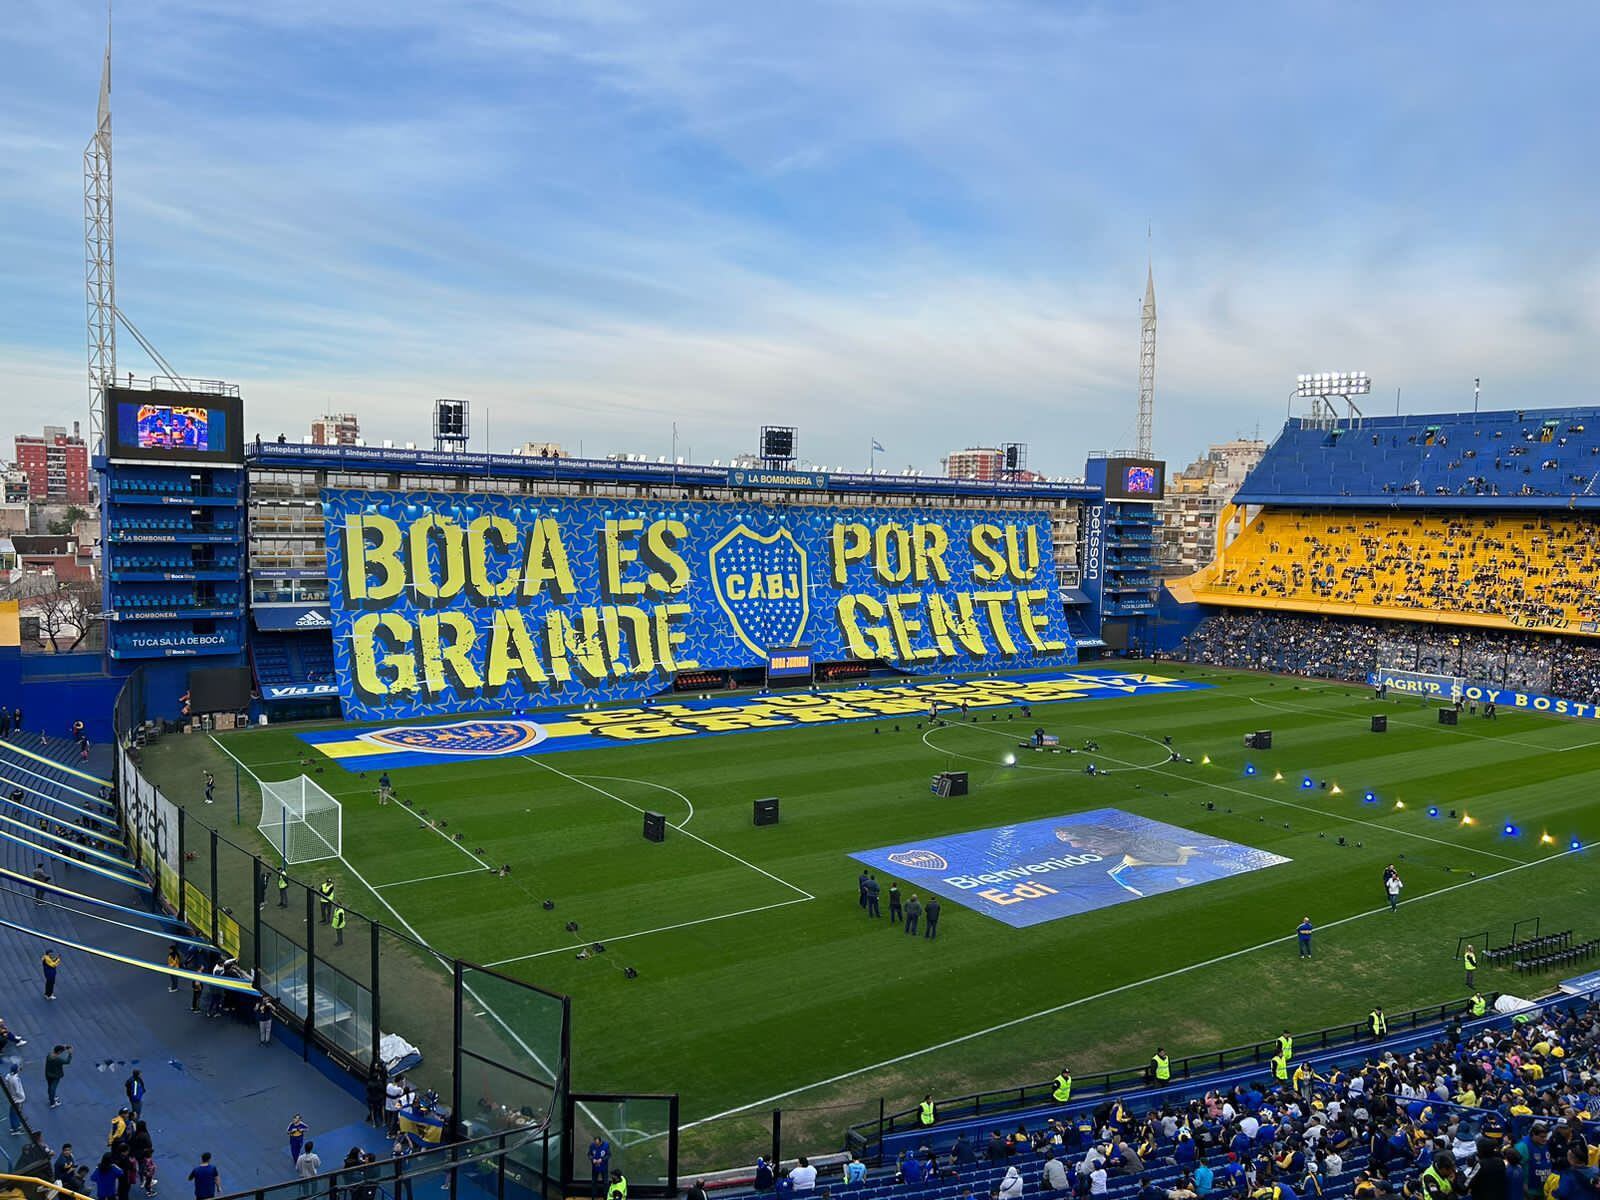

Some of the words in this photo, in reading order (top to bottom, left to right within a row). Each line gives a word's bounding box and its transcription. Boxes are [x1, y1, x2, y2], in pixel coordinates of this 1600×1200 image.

[263, 445, 301, 454] Sinteplast
[303, 447, 340, 456] Sinteplast
[345, 449, 381, 458] Sinteplast
[748, 474, 759, 483] LA
[760, 475, 812, 486] BOMBONERA
[346, 514, 577, 600] BOCA
[606, 517, 690, 594] ES
[833, 522, 950, 584] POR
[971, 523, 1039, 580] SU
[1089, 506, 1103, 580] betsson
[726, 572, 800, 600] CABJ
[174, 638, 186, 646] LA
[187, 636, 199, 645] DE
[200, 635, 225, 645] BOCA
[837, 589, 1066, 660] GENTE
[352, 604, 699, 695] GRANDE
[568, 703, 738, 726] EL
[753, 680, 1029, 708] UNICO
[592, 682, 1092, 741] GRANDE
[1450, 684, 1500, 703] SOY
[943, 853, 1103, 889] Bienvenido
[976, 881, 1059, 905] Edi
